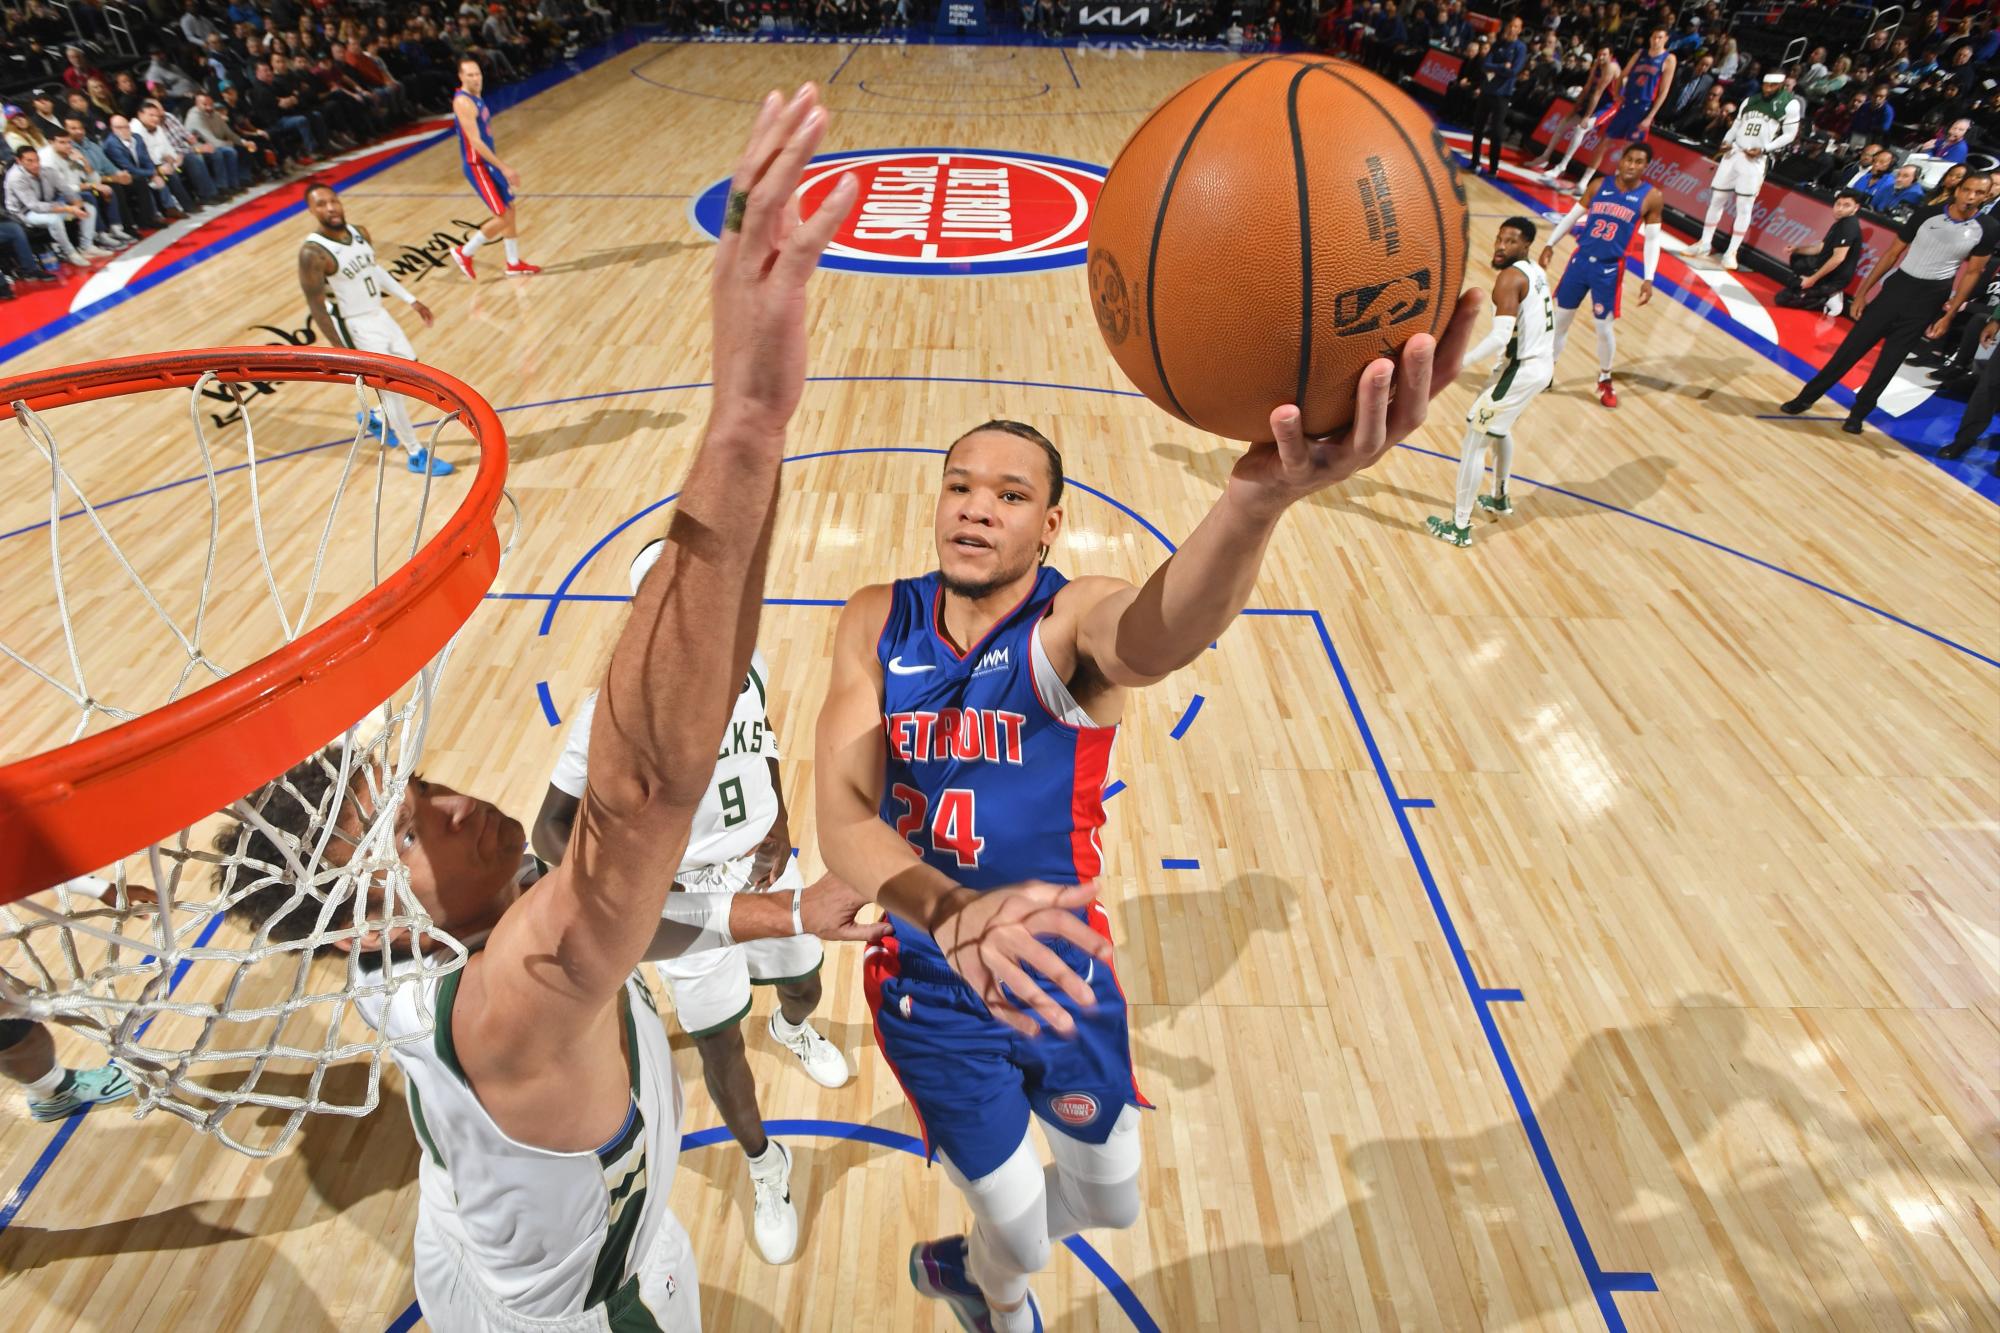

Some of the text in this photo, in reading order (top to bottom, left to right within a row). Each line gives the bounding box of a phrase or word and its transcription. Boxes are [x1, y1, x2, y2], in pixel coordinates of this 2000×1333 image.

[949, 4, 974, 12] HENRY
[1079, 5, 1149, 26] KIA
[949, 18, 977, 26] HEALTH
[1744, 122, 1762, 137] 99
[853, 166, 939, 241] PISTONS
[940, 167, 1013, 242] DETROIT
[1591, 202, 1636, 223] DETROIT
[1590, 219, 1618, 241] 23
[1385, 230, 1401, 257] BALL
[363, 276, 377, 297] 0
[1544, 297, 1554, 332] 5
[885, 706, 1027, 766] ETROIT
[718, 776, 747, 828] 9
[892, 782, 985, 869] 24
